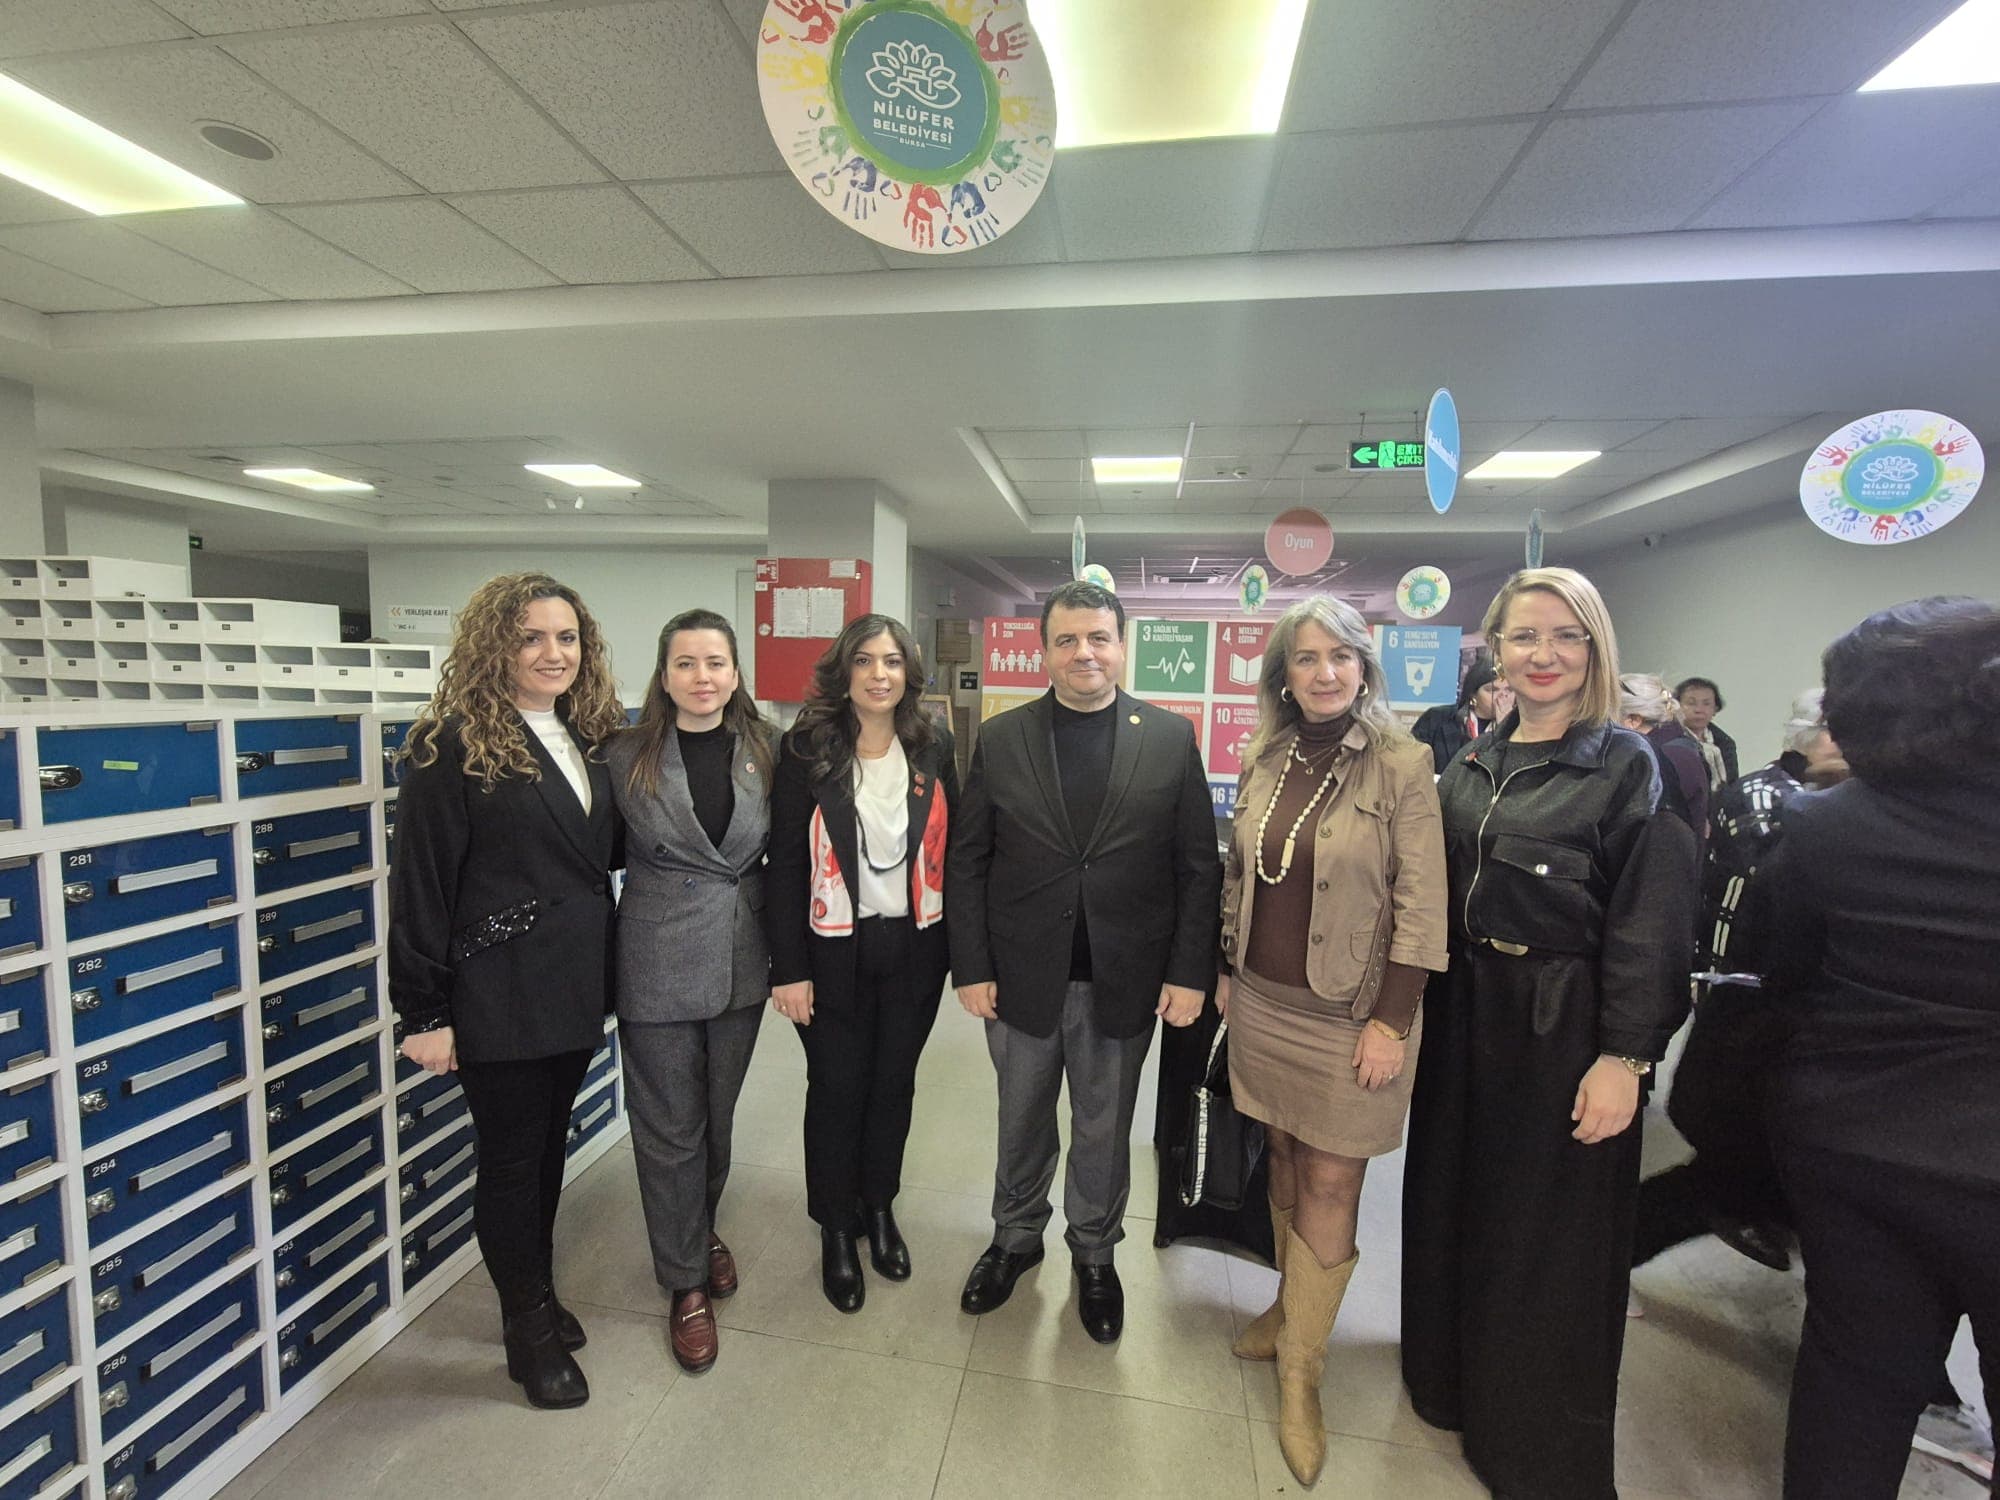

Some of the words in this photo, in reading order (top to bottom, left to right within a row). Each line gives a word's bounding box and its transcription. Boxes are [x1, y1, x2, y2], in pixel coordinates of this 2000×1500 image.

[873, 100, 955, 130] NİLÜFER
[873, 118, 952, 144] BELEDİYESİ
[899, 137, 926, 149] BURSA
[1396, 443, 1424, 455] EXIT
[1285, 532, 1314, 551] Oyun
[433, 609, 448, 617] KAFE
[991, 622, 998, 639] 1
[1142, 625, 1151, 642] 3
[1222, 627, 1231, 643] 4
[1389, 631, 1399, 648] 6
[1216, 707, 1231, 724] 10
[383, 725, 396, 734] 295
[1211, 787, 1225, 804] 16
[255, 823, 273, 834] 288
[69, 853, 93, 867] 281
[259, 911, 277, 923] 289
[77, 957, 102, 974] 282
[264, 995, 282, 1009] 290
[83, 1060, 108, 1079] 283
[270, 1079, 286, 1095] 291
[91, 1157, 117, 1178] 284
[272, 1162, 289, 1179] 292
[277, 1241, 294, 1257] 293
[97, 1255, 123, 1277] 285
[279, 1321, 297, 1340] 294
[103, 1353, 128, 1376] 286
[112, 1445, 136, 1469] 287
